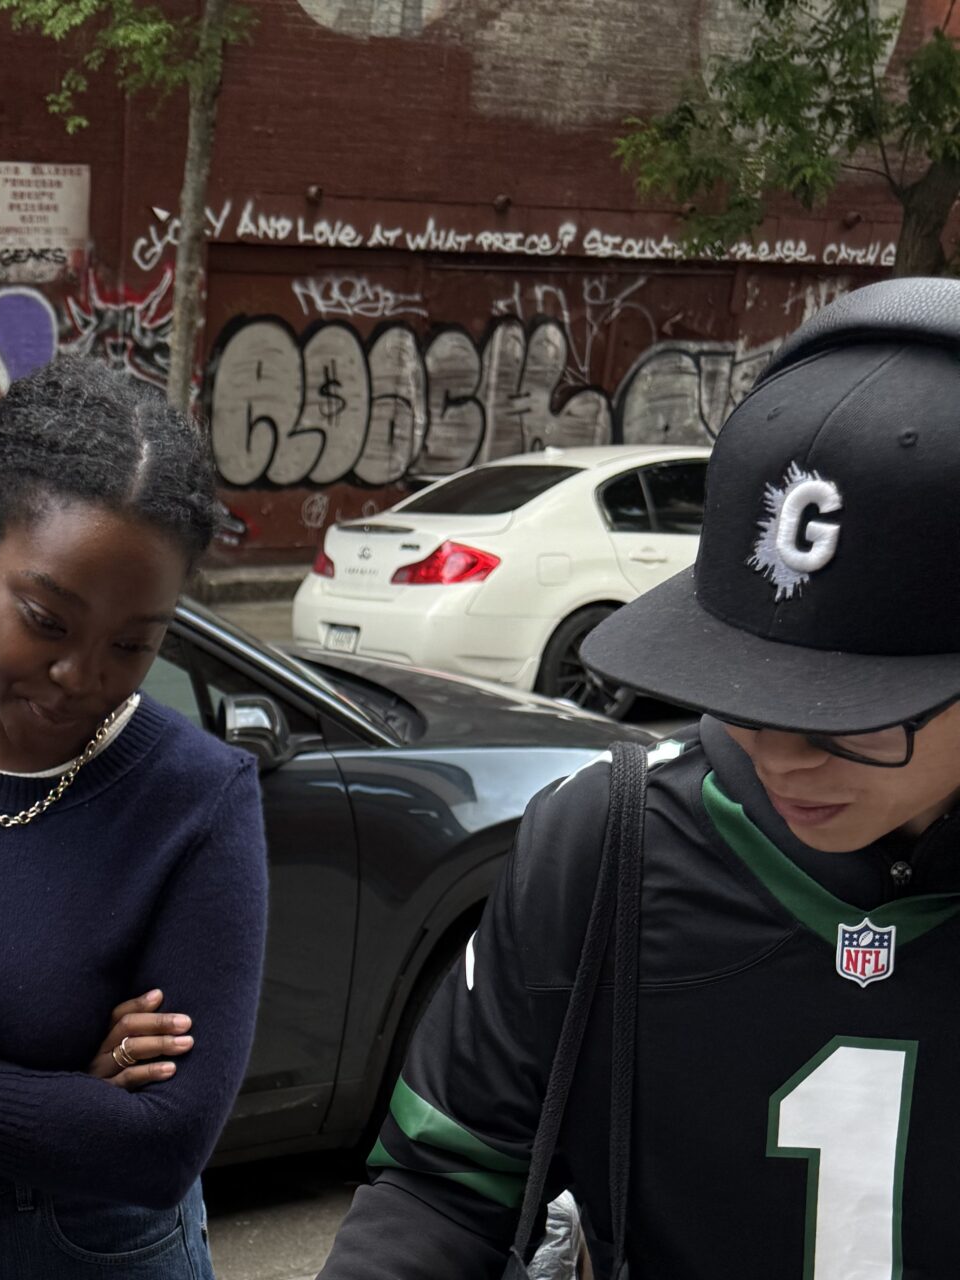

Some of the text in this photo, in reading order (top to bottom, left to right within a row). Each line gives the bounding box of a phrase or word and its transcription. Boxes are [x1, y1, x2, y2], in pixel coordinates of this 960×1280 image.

[132, 201, 232, 271] GLOY
[237, 200, 293, 241] AND
[366, 223, 402, 247] AT
[405, 217, 473, 253] WHAT
[776, 479, 843, 573] G
[844, 948, 886, 977] NFL
